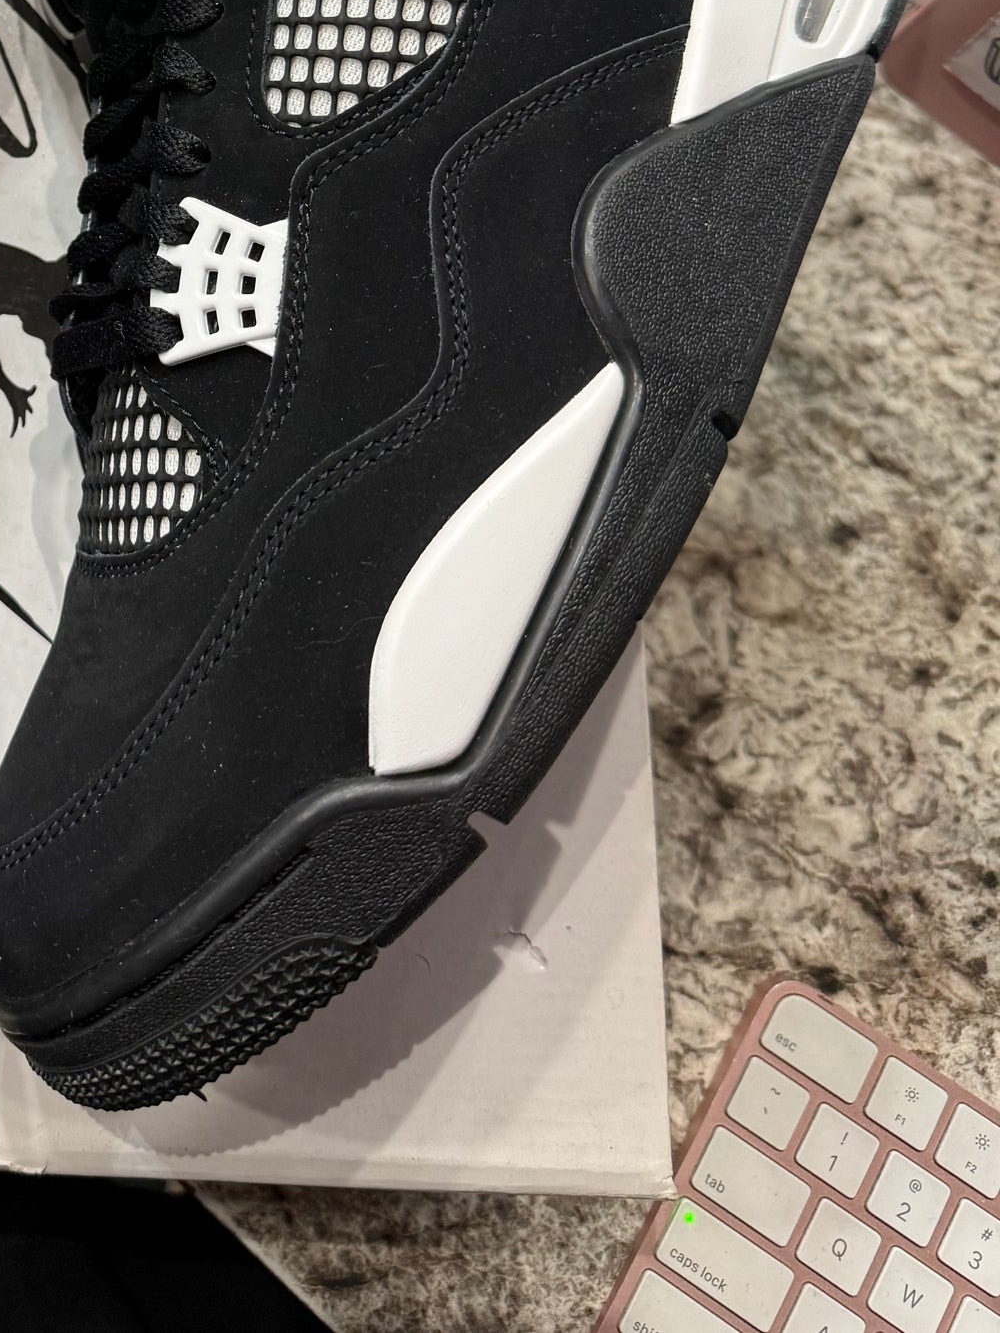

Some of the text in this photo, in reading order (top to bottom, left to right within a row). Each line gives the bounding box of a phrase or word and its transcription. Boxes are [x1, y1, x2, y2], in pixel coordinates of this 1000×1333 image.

[775, 1033, 797, 1052] esc
[894, 1113, 906, 1126] F1
[840, 1131, 849, 1146] !
[828, 1154, 839, 1172] 1
[964, 1160, 978, 1174] F2
[704, 1172, 726, 1194] tab
[908, 1178, 923, 1194] @
[895, 1201, 912, 1223] 2
[980, 1228, 994, 1242] #
[831, 1237, 848, 1262] Q
[669, 1245, 728, 1293] caps lock
[967, 1250, 983, 1270] 3
[902, 1283, 924, 1309] W
